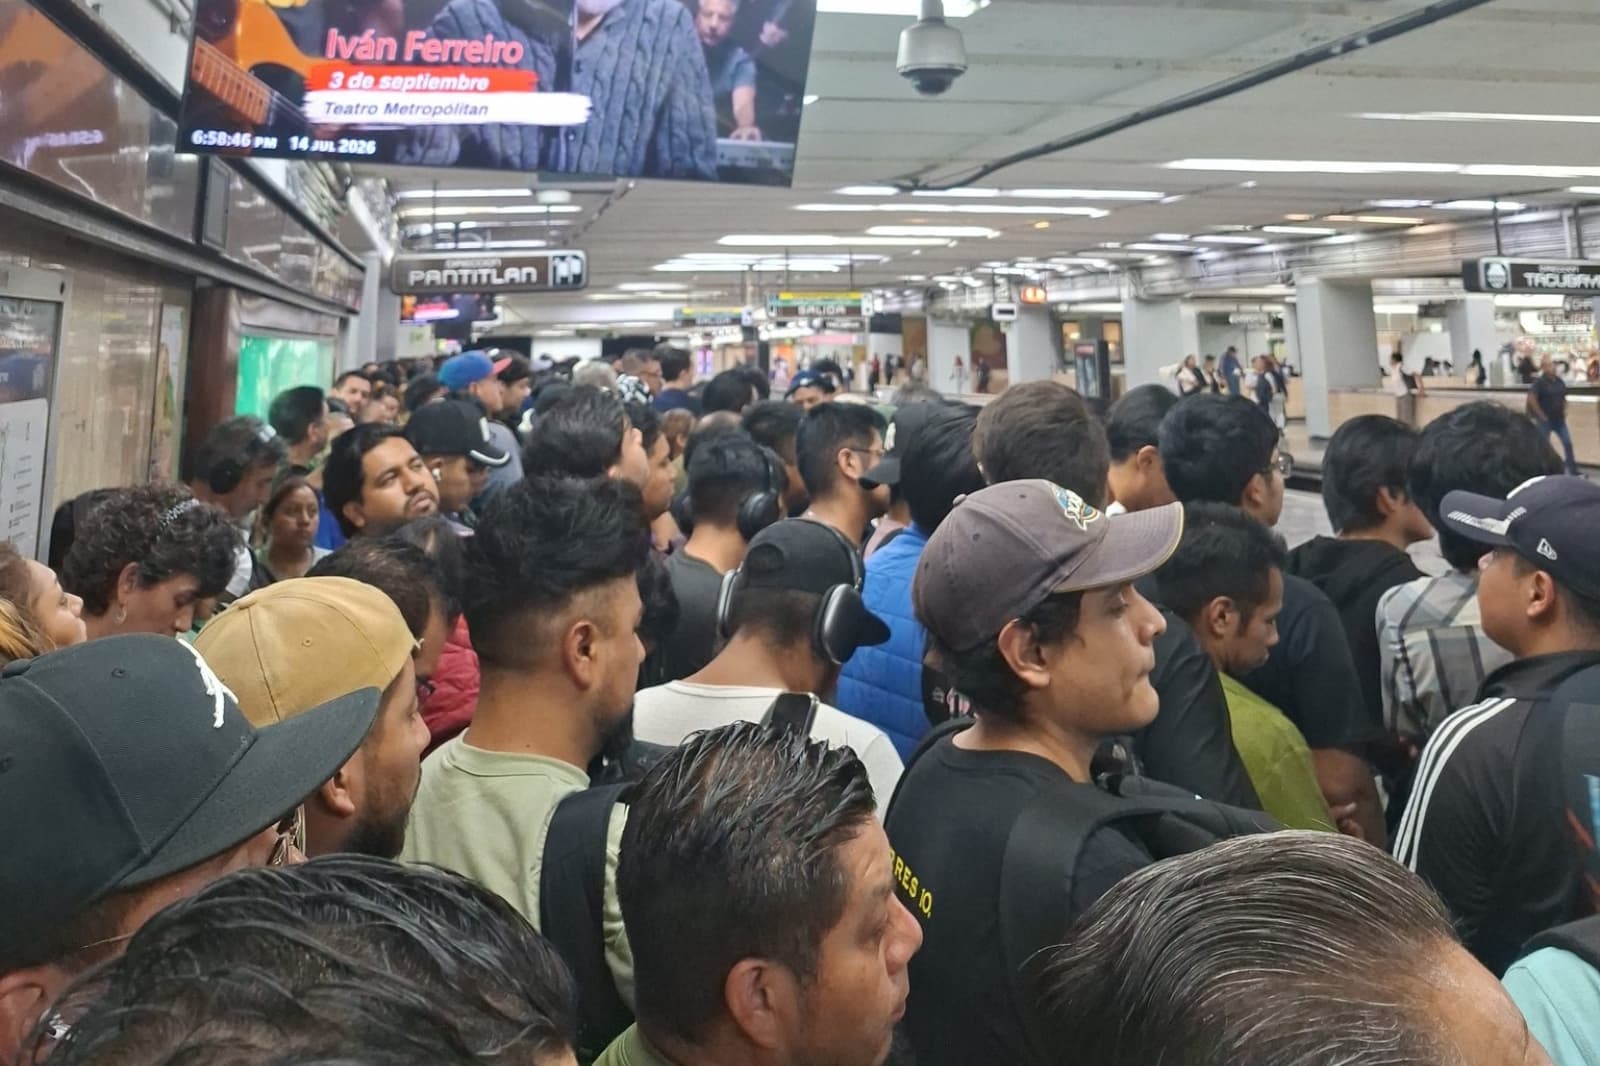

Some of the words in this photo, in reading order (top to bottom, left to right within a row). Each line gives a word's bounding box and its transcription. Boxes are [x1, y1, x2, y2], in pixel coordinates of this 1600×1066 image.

[325, 27, 397, 60] Iván
[403, 30, 524, 64] Ferreiro
[328, 71, 345, 89] 3
[347, 71, 375, 90] de
[378, 73, 490, 92] septiembre
[325, 102, 378, 115] Teatro
[383, 103, 489, 117] Metropólitan
[191, 129, 251, 147] 6:58:46
[253, 136, 278, 149] PM
[288, 136, 309, 151] 14
[310, 140, 336, 152] JUL
[338, 139, 376, 154] 2026
[408, 267, 538, 286] PANTITLAN
[798, 304, 847, 316] SALIDA
